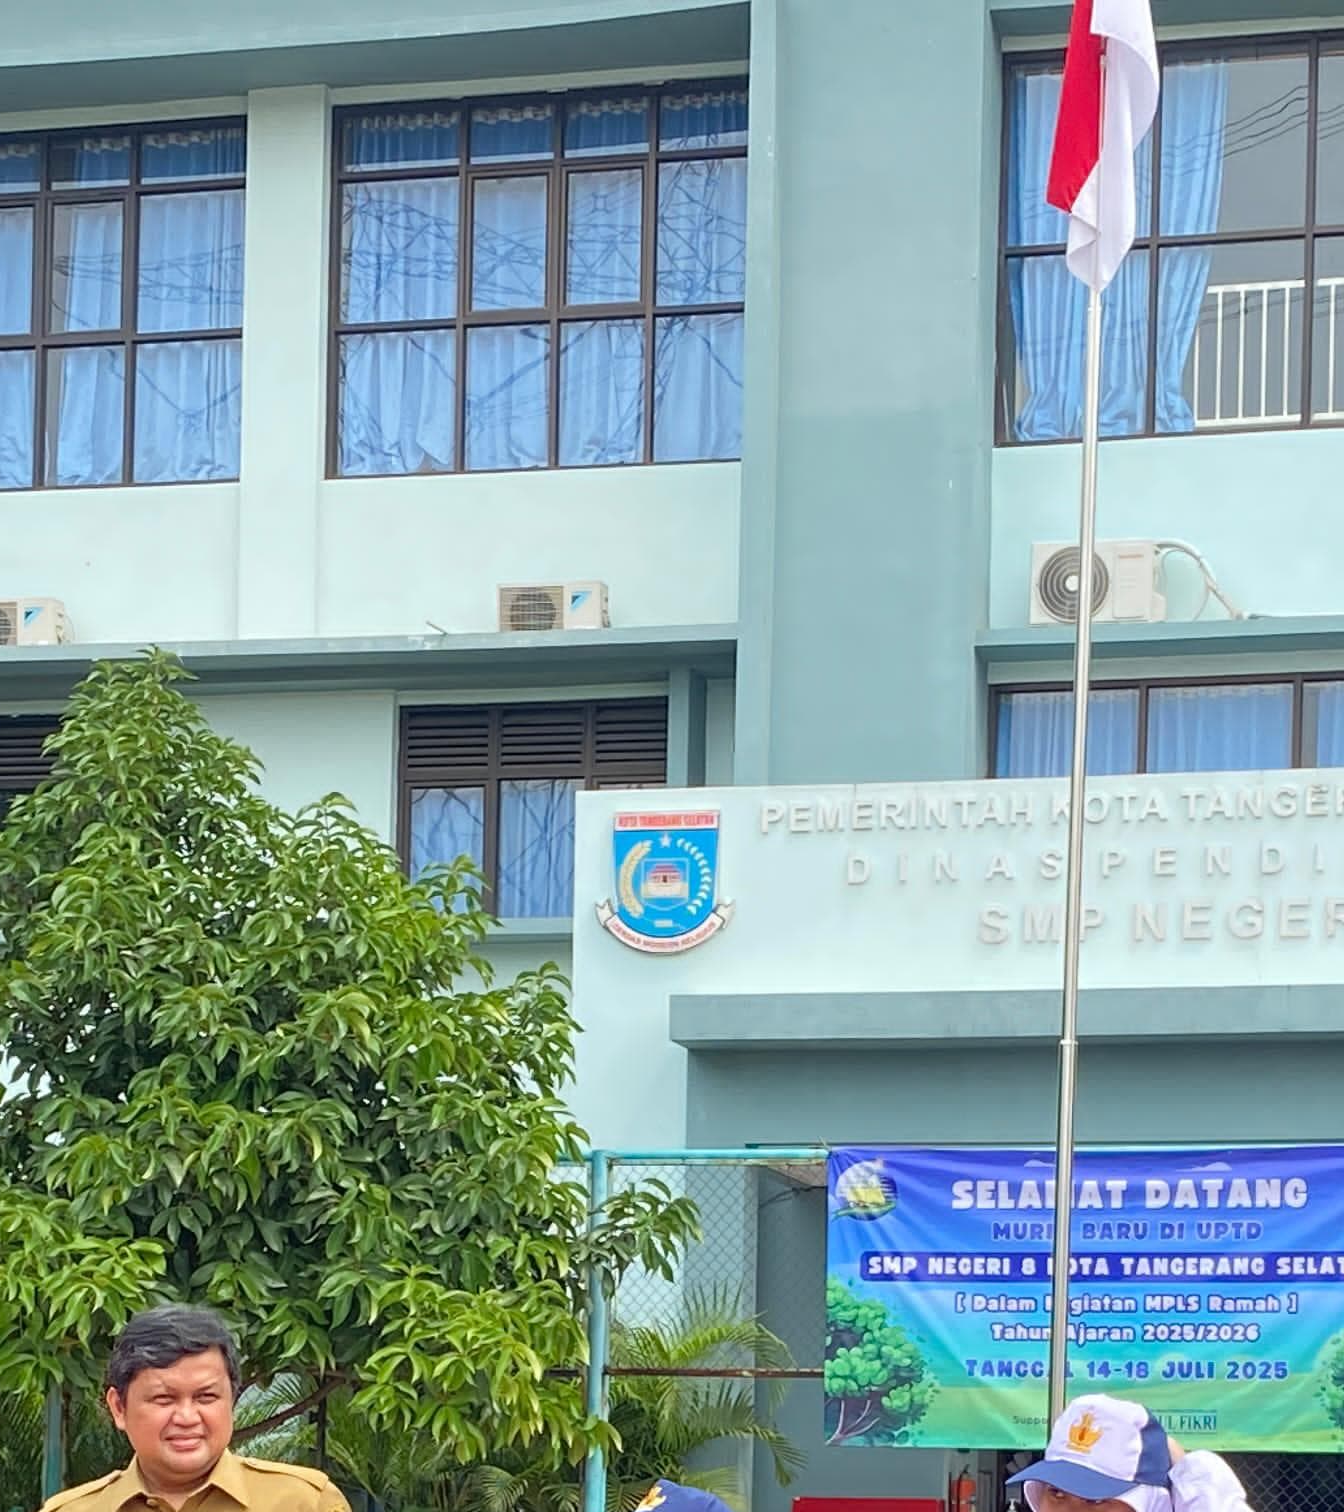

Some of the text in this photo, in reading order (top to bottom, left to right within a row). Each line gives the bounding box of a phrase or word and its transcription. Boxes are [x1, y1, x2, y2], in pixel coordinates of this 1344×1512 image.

[761, 798, 1032, 833] PEMERINTAH
[1050, 791, 1168, 824] KOTA
[846, 848, 1063, 885] DINAS
[978, 902, 1104, 944] SMP
[1146, 1178, 1308, 1210] DATANG
[992, 1221, 1263, 1241] MURI BARU DI UPTD
[867, 1256, 918, 1275] SMP
[927, 1256, 1011, 1276] NEGERI
[1020, 1256, 1037, 1276] 8
[1120, 1256, 1265, 1276] TANGERANG
[972, 1294, 1037, 1313] Dalam
[1044, 1294, 1138, 1316] giatan
[1144, 1294, 1201, 1313] MPLS
[1207, 1293, 1281, 1313] Ramah
[991, 1322, 1052, 1341] Tahun
[1142, 1322, 1262, 1342] 2025/2026
[966, 1359, 1289, 1380] TANGGL 14-18 JULI 2025
[1180, 1415, 1217, 1430] FIKRI
